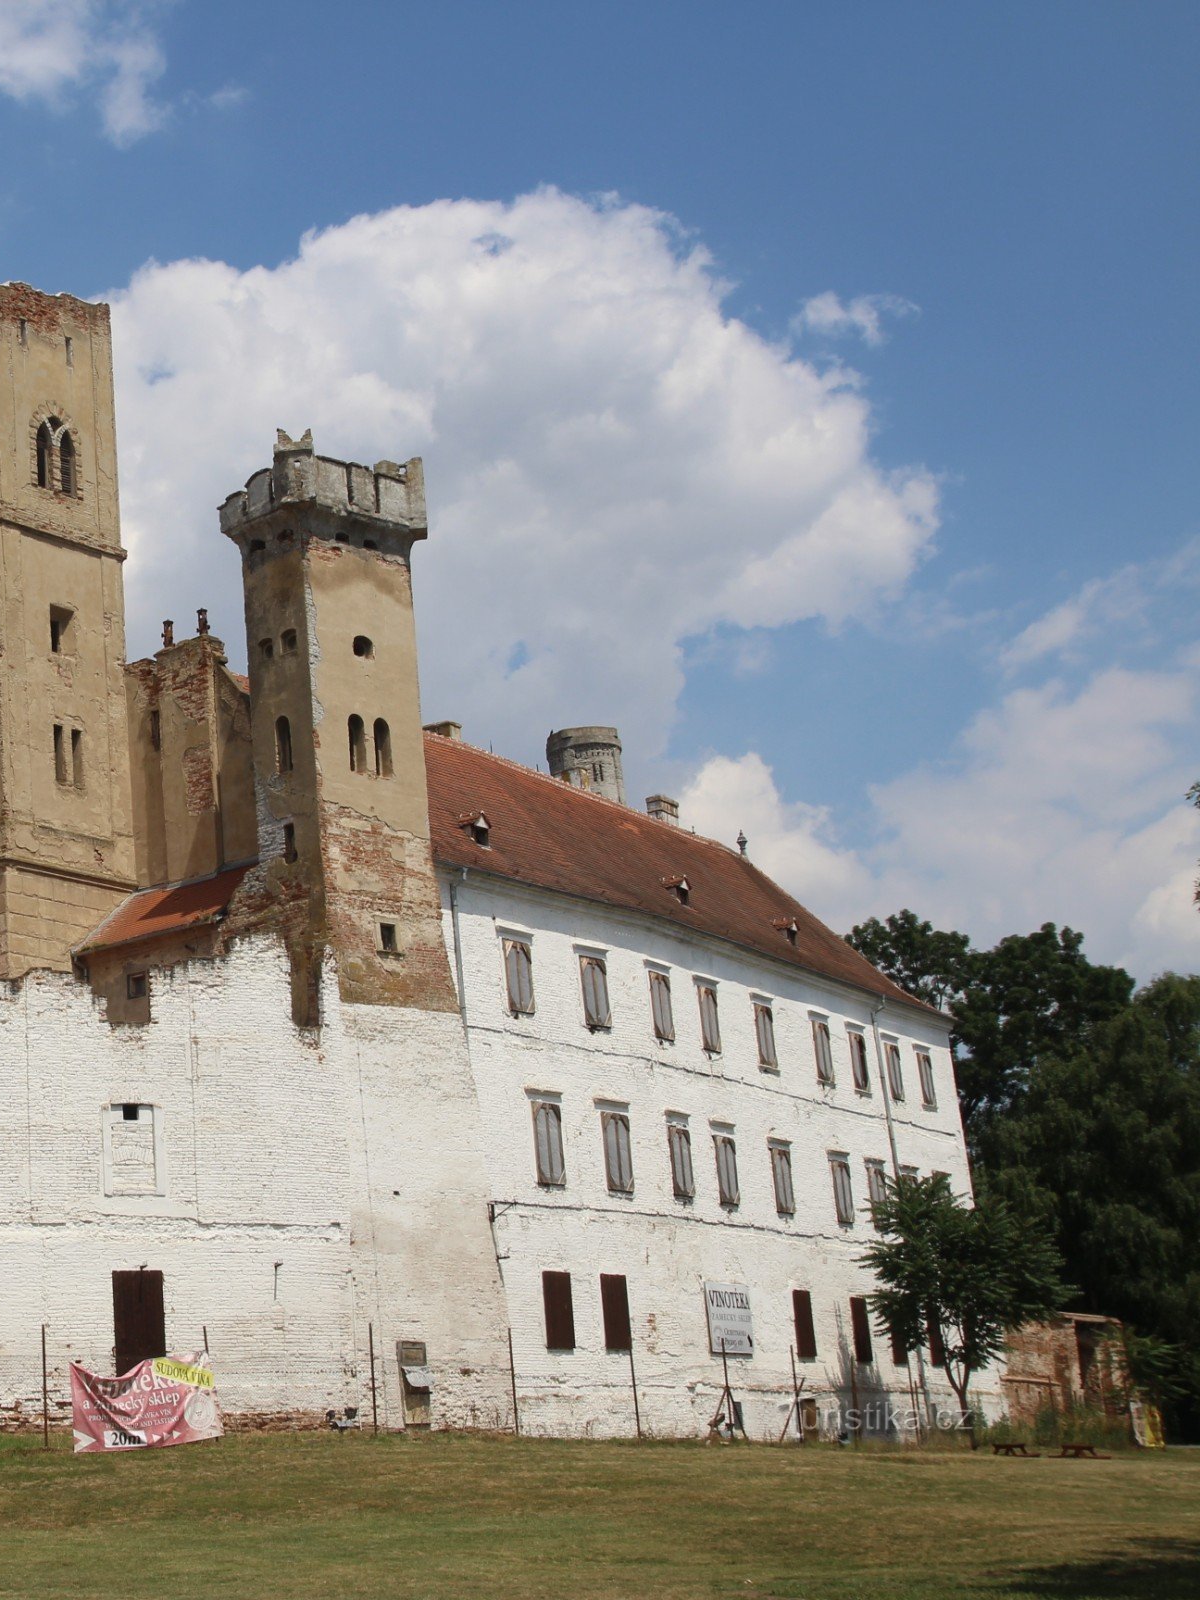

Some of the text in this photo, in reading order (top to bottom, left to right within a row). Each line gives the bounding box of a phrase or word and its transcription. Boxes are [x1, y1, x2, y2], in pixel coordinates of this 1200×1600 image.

[708, 1288, 750, 1310] VINOTÉKA
[156, 1362, 188, 1382] SUDOVÁ
[83, 1401, 90, 1410] a
[148, 1391, 180, 1406] sklep
[112, 1431, 142, 1446] 20m
